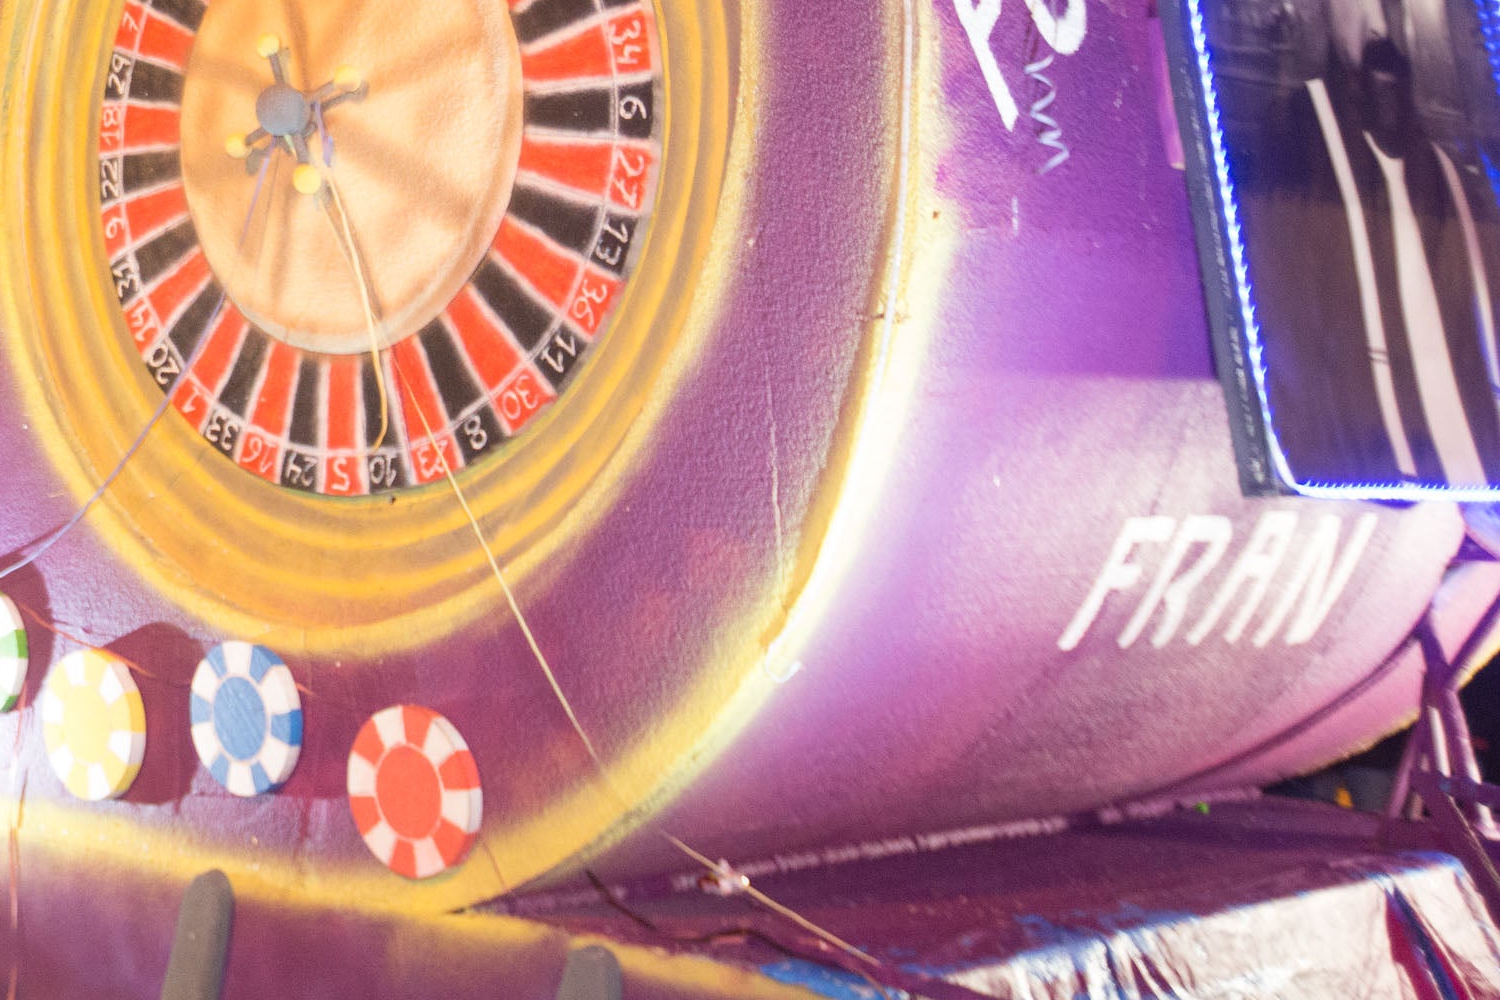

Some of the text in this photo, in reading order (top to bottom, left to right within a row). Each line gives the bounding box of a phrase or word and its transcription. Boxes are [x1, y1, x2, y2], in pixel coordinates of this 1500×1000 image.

[122, 12, 139, 32] 7
[610, 19, 642, 64] 34
[108, 53, 131, 95] 29
[101, 107, 122, 145] 18
[619, 95, 647, 120] 6
[101, 158, 119, 199] 22
[605, 150, 645, 207] 27
[595, 221, 628, 265] 13
[131, 300, 160, 341] 14
[572, 279, 607, 326] 36
[149, 342, 182, 384] 20
[540, 335, 576, 373] 11
[182, 386, 202, 413] 1
[501, 375, 538, 420] 30
[205, 415, 240, 450] 33
[463, 415, 487, 449] 8
[241, 436, 278, 473] 16
[285, 453, 318, 486] 24
[370, 454, 397, 486] 10
[417, 440, 450, 478] 23
[331, 457, 351, 491] 5
[1056, 510, 1379, 651] FRAN
